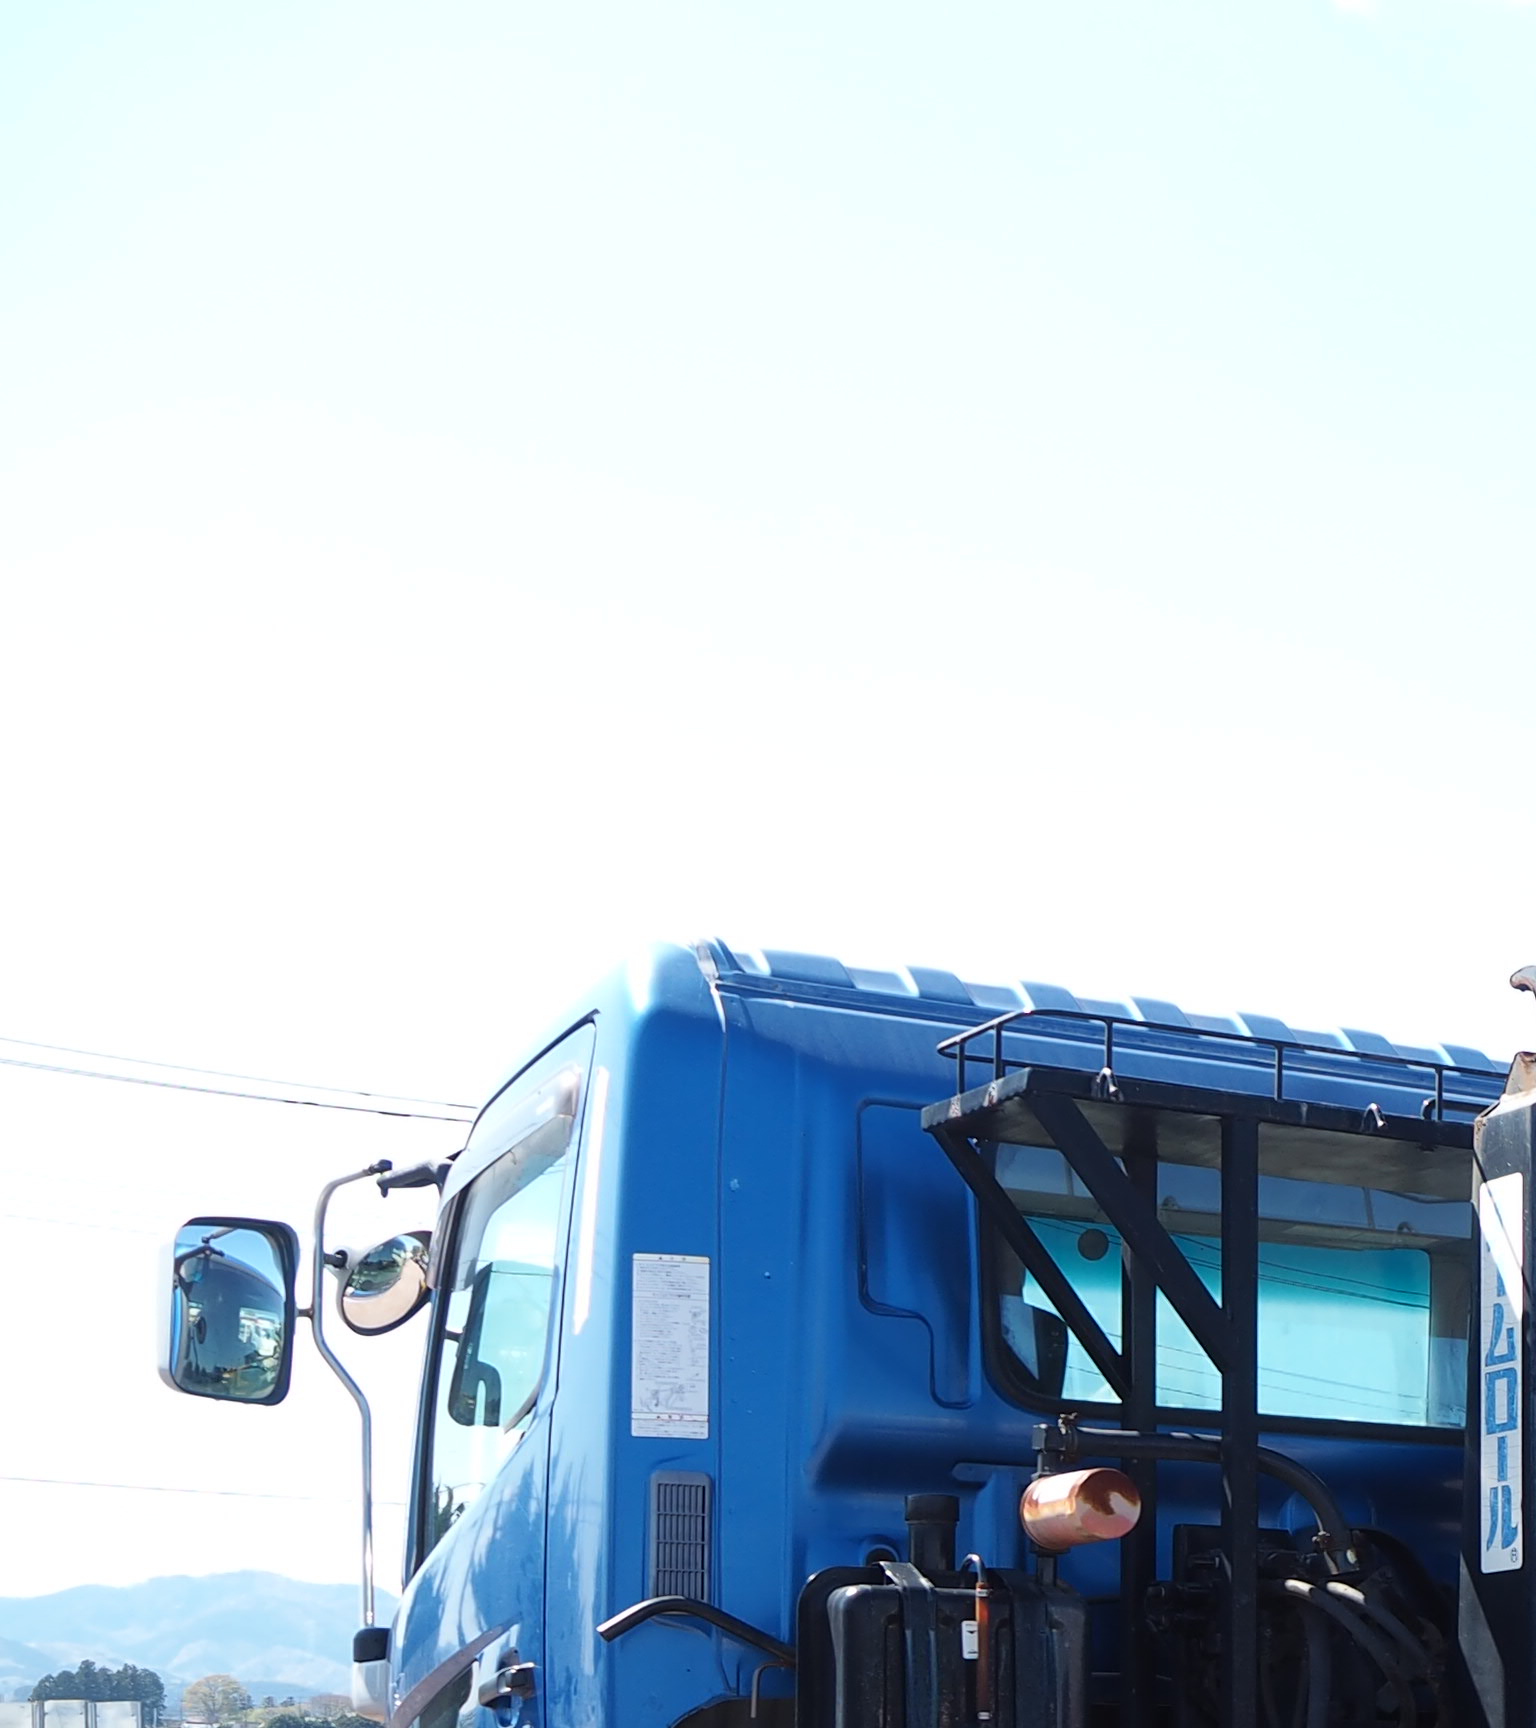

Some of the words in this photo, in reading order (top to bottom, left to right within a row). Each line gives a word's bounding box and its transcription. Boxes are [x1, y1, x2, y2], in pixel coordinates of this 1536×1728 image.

[1484, 1238, 1519, 1553] ームロール
